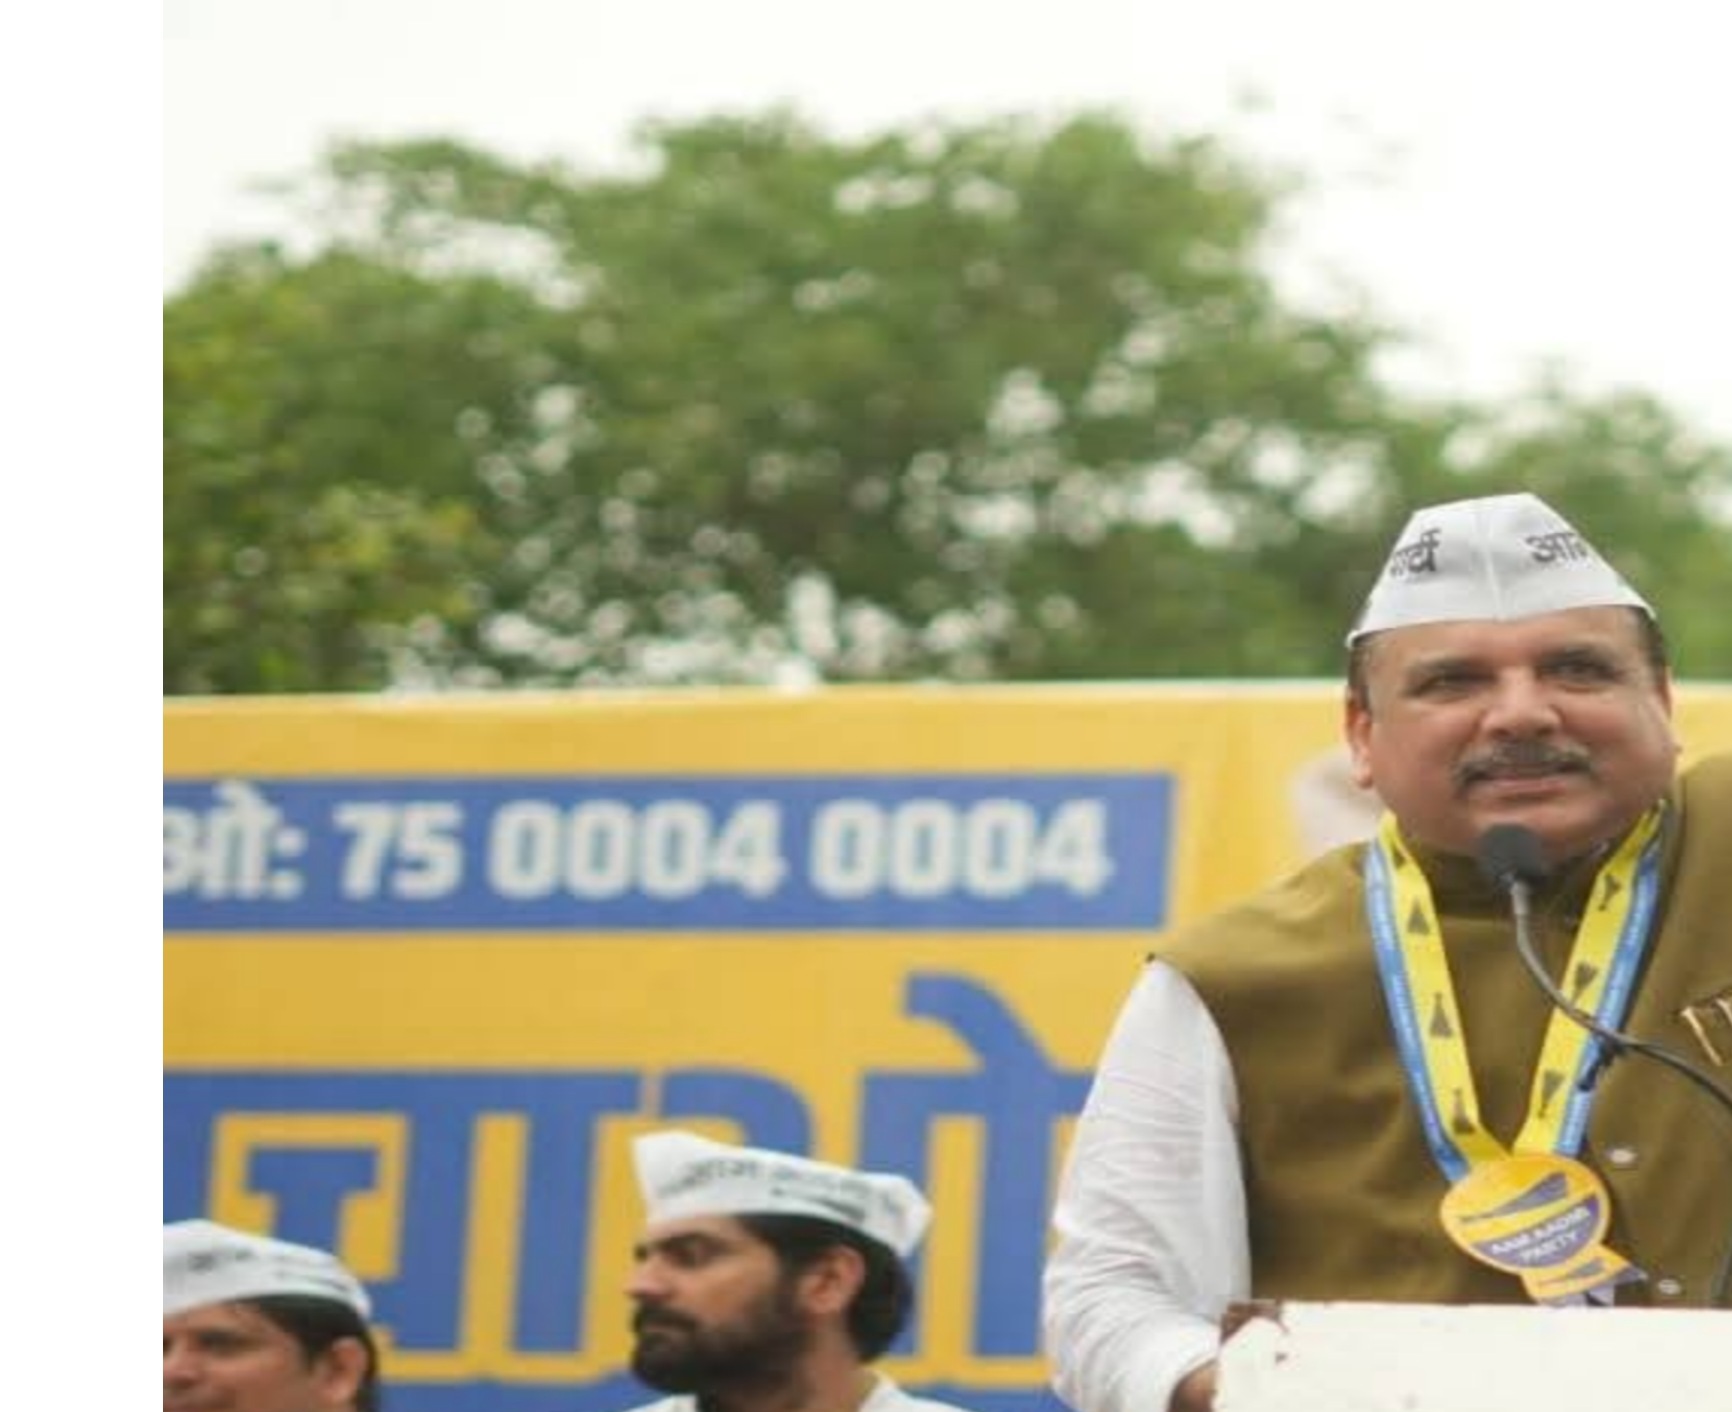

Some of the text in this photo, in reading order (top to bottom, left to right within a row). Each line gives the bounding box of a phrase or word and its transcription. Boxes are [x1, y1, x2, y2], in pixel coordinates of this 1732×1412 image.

[331, 799, 463, 901] 75
[486, 799, 786, 901] 0004
[811, 799, 1112, 901] 0004
